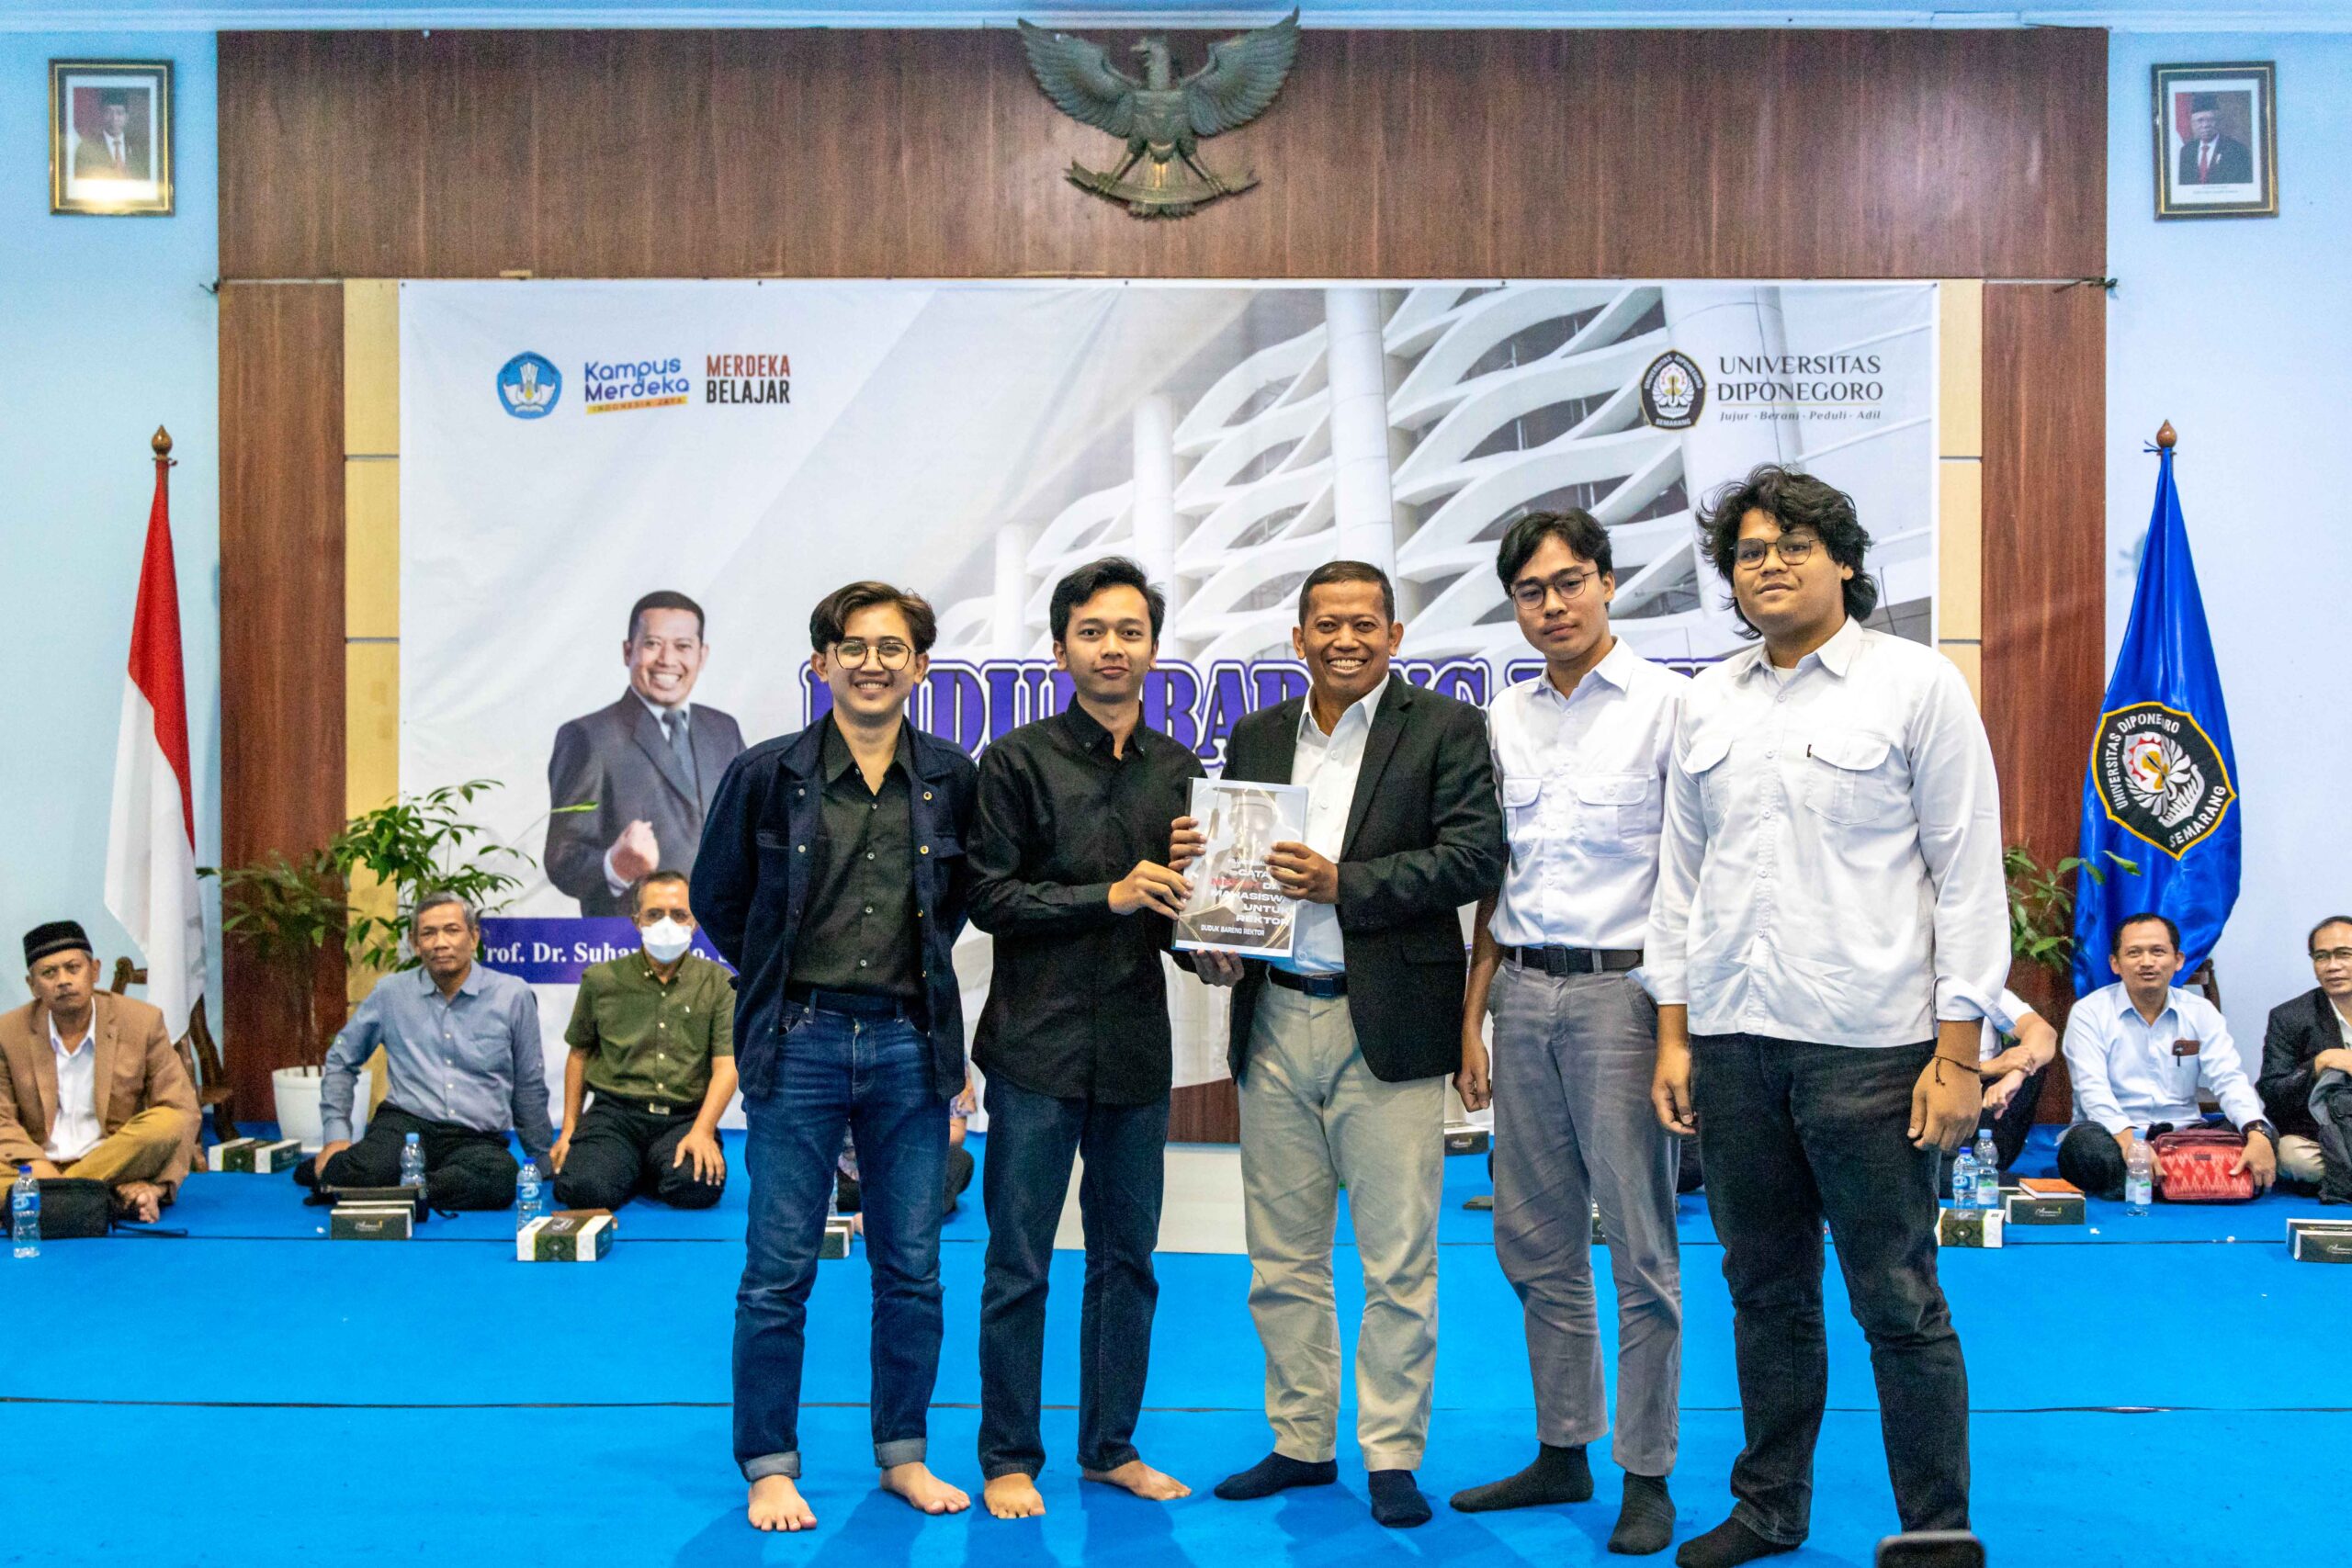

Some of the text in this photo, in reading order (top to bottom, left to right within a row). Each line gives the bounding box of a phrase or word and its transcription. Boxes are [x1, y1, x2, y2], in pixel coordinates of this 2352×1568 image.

[584, 357, 682, 383] Kampus
[706, 355, 791, 378] MERDEKA
[1719, 355, 1882, 375] UNIVERSITAS
[584, 375, 690, 402] Merdeka
[706, 379, 791, 404] BELAJAR
[1717, 381, 1884, 401] DIPONEGORO
[1719, 411, 1750, 423] Jujur
[1809, 411, 1848, 421] Peduli
[1857, 411, 1882, 421] Adil
[2105, 732, 2130, 810] UNIVERSITAS
[2168, 785, 2227, 848] SEMARANG
[482, 942, 526, 963] rof.
[532, 942, 567, 963] Dr.
